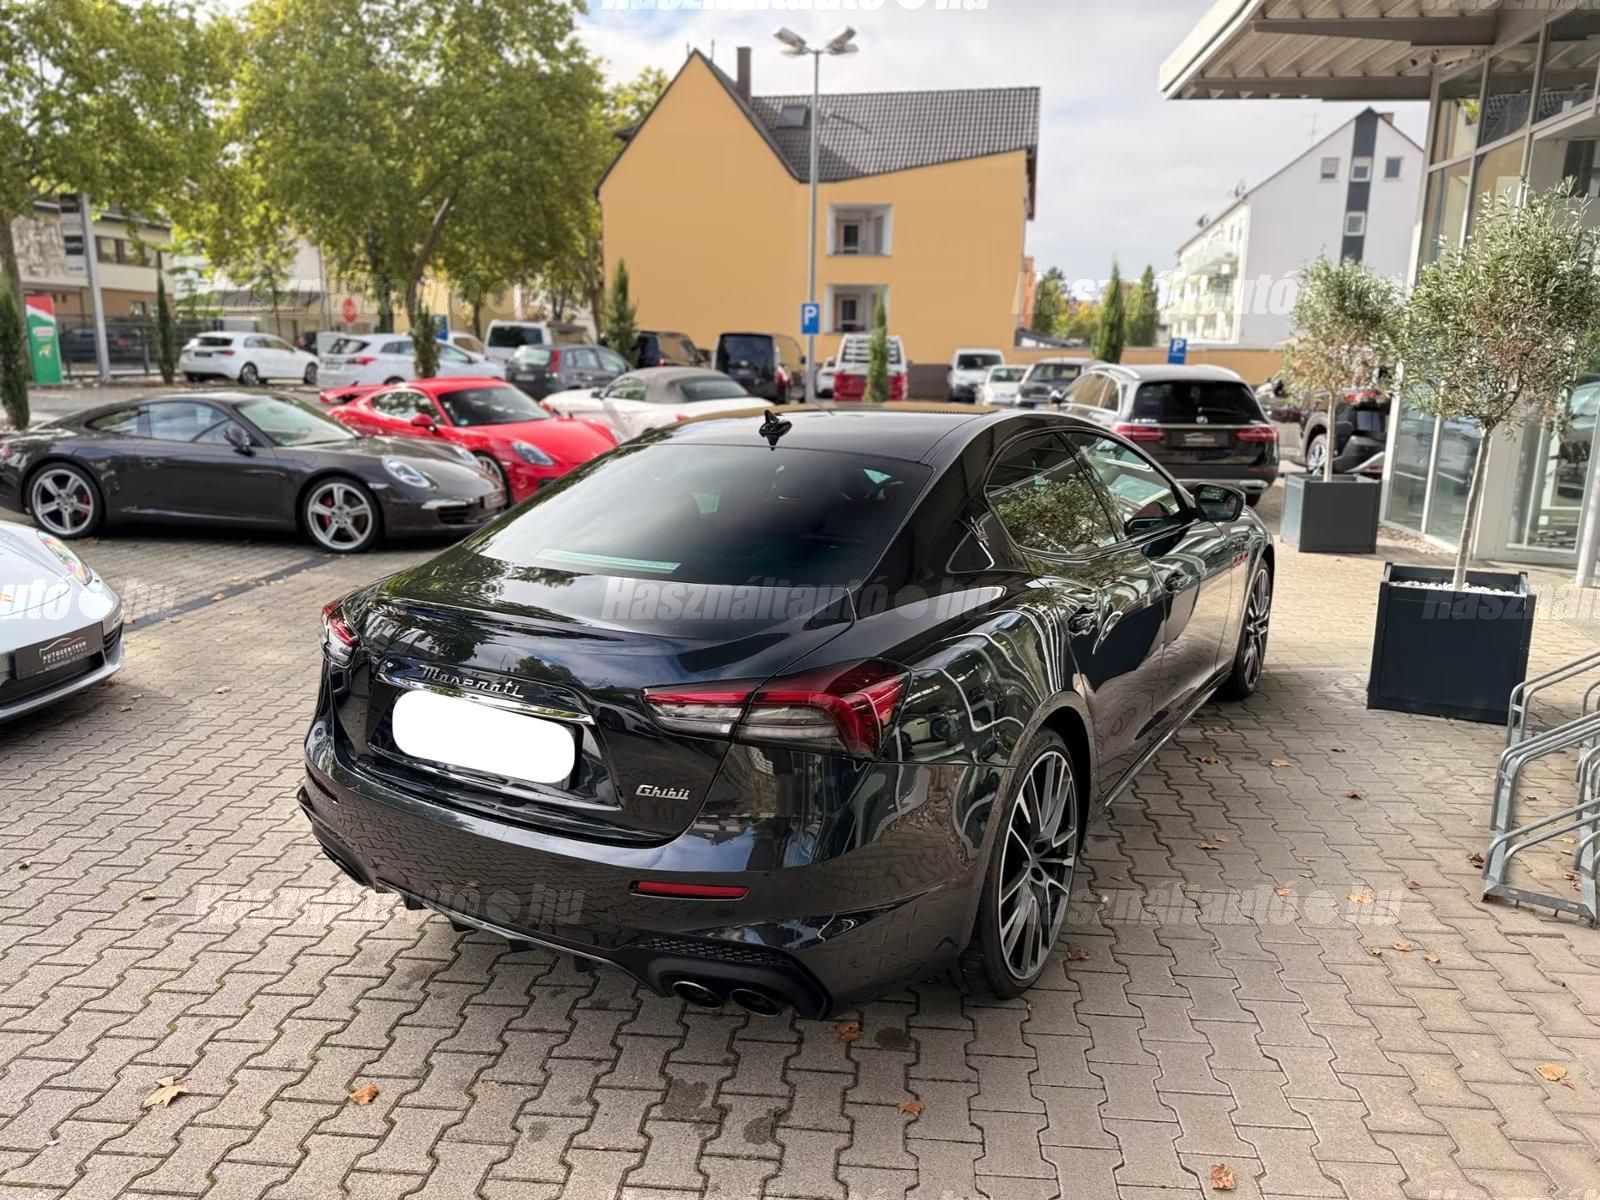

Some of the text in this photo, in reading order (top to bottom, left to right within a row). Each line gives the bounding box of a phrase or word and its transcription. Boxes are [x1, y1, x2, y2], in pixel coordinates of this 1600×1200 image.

[804, 306, 817, 325] P
[1172, 340, 1185, 352] P
[42, 641, 87, 661] AUTOZENTRUM
[420, 664, 525, 698] Maserati
[635, 784, 690, 800] Ghibli
